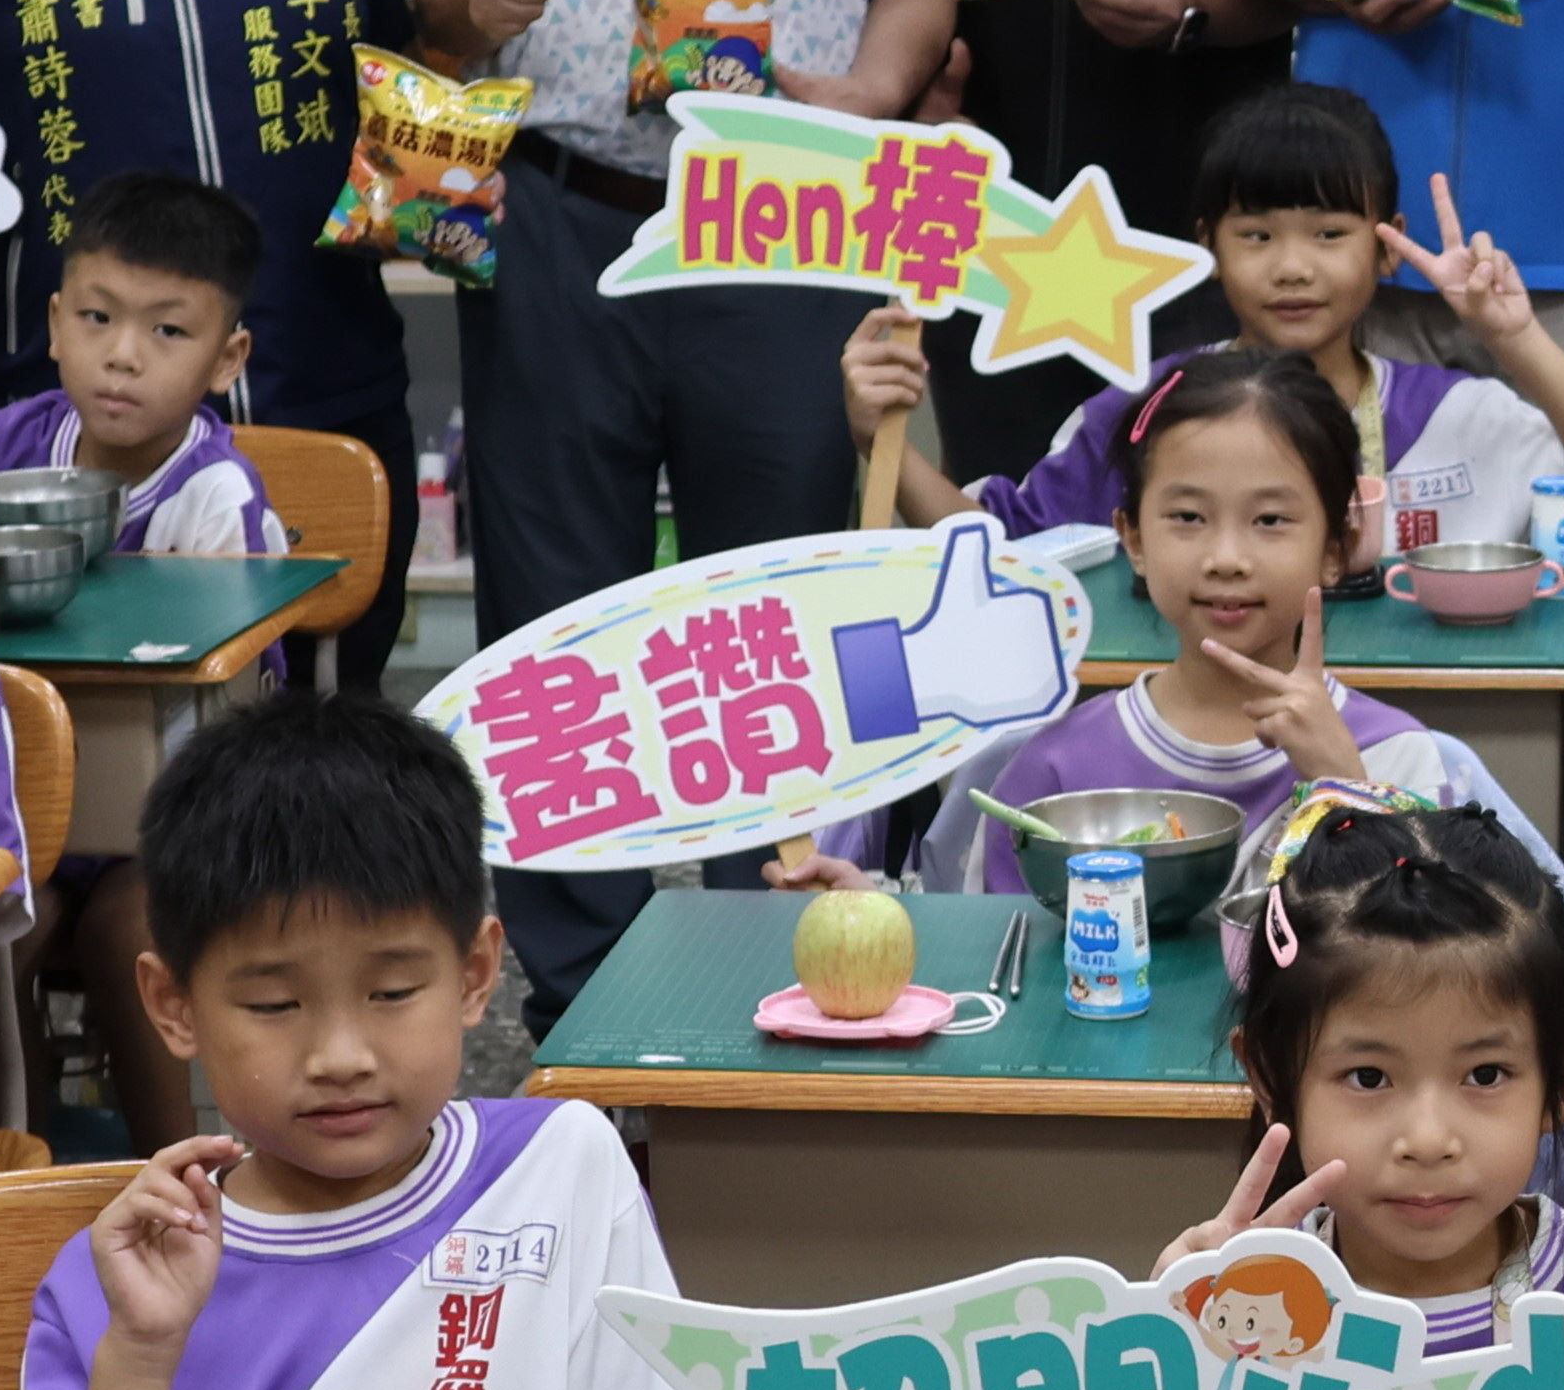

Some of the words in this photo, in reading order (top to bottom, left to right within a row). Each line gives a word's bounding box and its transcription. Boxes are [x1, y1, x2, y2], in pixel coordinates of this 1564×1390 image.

[242, 4, 293, 156] 服務團隊
[681, 138, 990, 303] Hen棒
[1072, 919, 1118, 940] MILK
[475, 1234, 548, 1274] 2114
